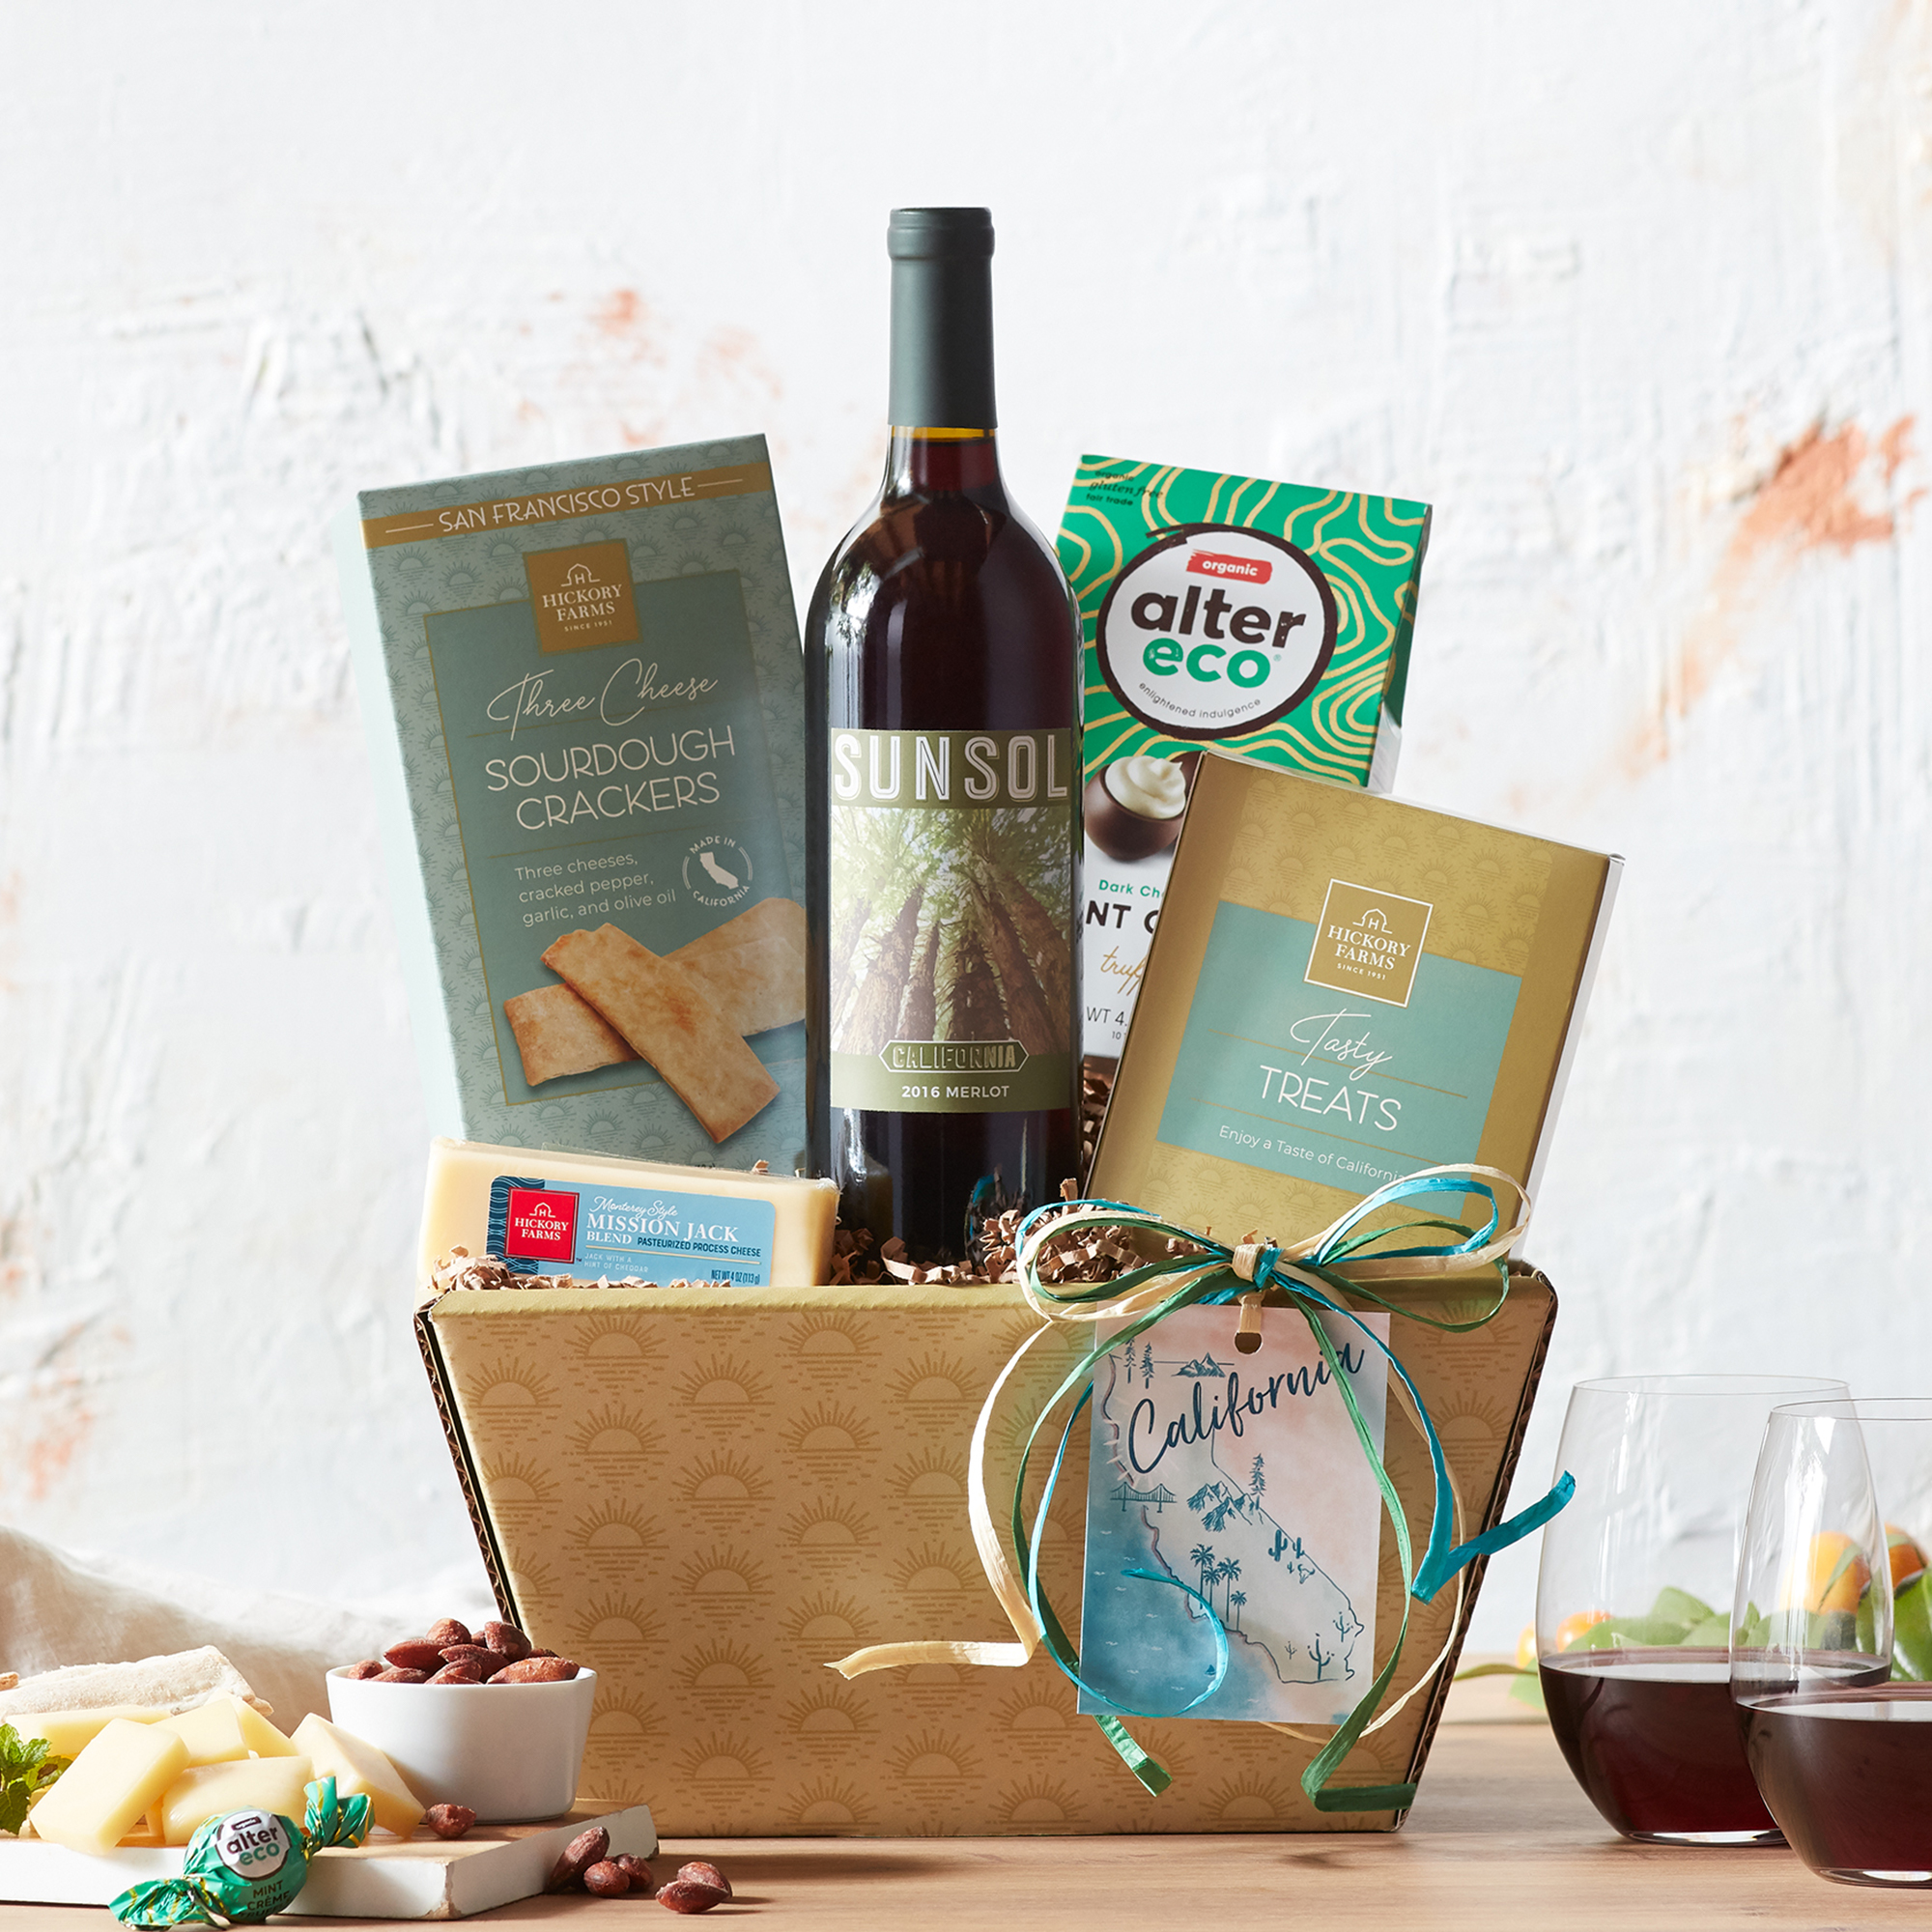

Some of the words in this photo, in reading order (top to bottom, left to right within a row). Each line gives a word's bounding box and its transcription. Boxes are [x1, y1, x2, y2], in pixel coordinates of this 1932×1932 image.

[1094, 470, 1134, 482] organic
[1086, 493, 1103, 502] fair
[1106, 496, 1134, 506] trade
[1089, 480, 1134, 495] gluten
[1133, 485, 1164, 499] free
[438, 506, 486, 532] SAN
[492, 488, 621, 525] FRANCISCO
[625, 476, 696, 505] STYLE
[1202, 559, 1259, 577] organic
[542, 583, 622, 609] HICKORY
[556, 601, 615, 622] FARMS
[1131, 584, 1307, 649] alter
[564, 622, 591, 633] SINCE
[594, 619, 612, 628] 1951
[1143, 638, 1271, 689] eco
[486, 668, 596, 742] Three
[599, 657, 719, 726] Cheese
[1139, 682, 1197, 718] enlightened
[1199, 698, 1262, 720] indulgence
[485, 724, 736, 792] SOURDOUGH
[834, 733, 1068, 803] SUNSOL
[516, 771, 721, 830] CRACKERS
[689, 835, 721, 855] MADE
[724, 837, 736, 848] IN
[514, 864, 563, 881] Three
[567, 853, 639, 874] cheeses,
[519, 880, 585, 903] cracked
[589, 872, 655, 895] pepper,
[693, 885, 751, 907] CALIFORNIA
[1098, 879, 1134, 895] Dark
[1140, 885, 1165, 898] Ch
[523, 905, 574, 927] garlic,
[578, 898, 611, 917] and
[613, 895, 653, 911] olive
[657, 888, 676, 906] oil
[1327, 924, 1411, 957] HICKORY
[1334, 943, 1396, 971] FARMS
[1337, 962, 1364, 976] SINCE
[1367, 970, 1386, 980] 1951
[1086, 1006, 1112, 1024] WT
[893, 1044, 1016, 1069] CALIFORNIA
[1290, 1008, 1393, 1081] Tasty
[901, 1085, 941, 1098] 2016
[946, 1085, 1009, 1098] MERLOT
[1259, 1064, 1402, 1132] TREATS
[1218, 1124, 1262, 1149] Enjoy
[1263, 1138, 1272, 1151] a
[1276, 1139, 1315, 1161] Taste
[1318, 1152, 1335, 1166] of
[589, 1196, 646, 1218] Monterey
[646, 1200, 678, 1220] Style
[515, 1217, 569, 1232] HICKORY
[522, 1228, 561, 1241] FARMS
[586, 1212, 681, 1237] MISSION
[683, 1222, 739, 1242] JACK
[586, 1231, 633, 1245] BLEND
[637, 1236, 691, 1250] PASTEURIZED
[693, 1242, 729, 1254] PROCESS
[730, 1245, 761, 1258] CHEESE
[606, 1254, 625, 1263] WITH
[615, 1264, 649, 1272] CHEDDAR
[711, 1269, 721, 1280] NET
[1127, 1341, 1366, 1474] California
[226, 1827, 278, 1855] alter
[240, 1842, 280, 1865] eco
[253, 1880, 284, 1898] MINT
